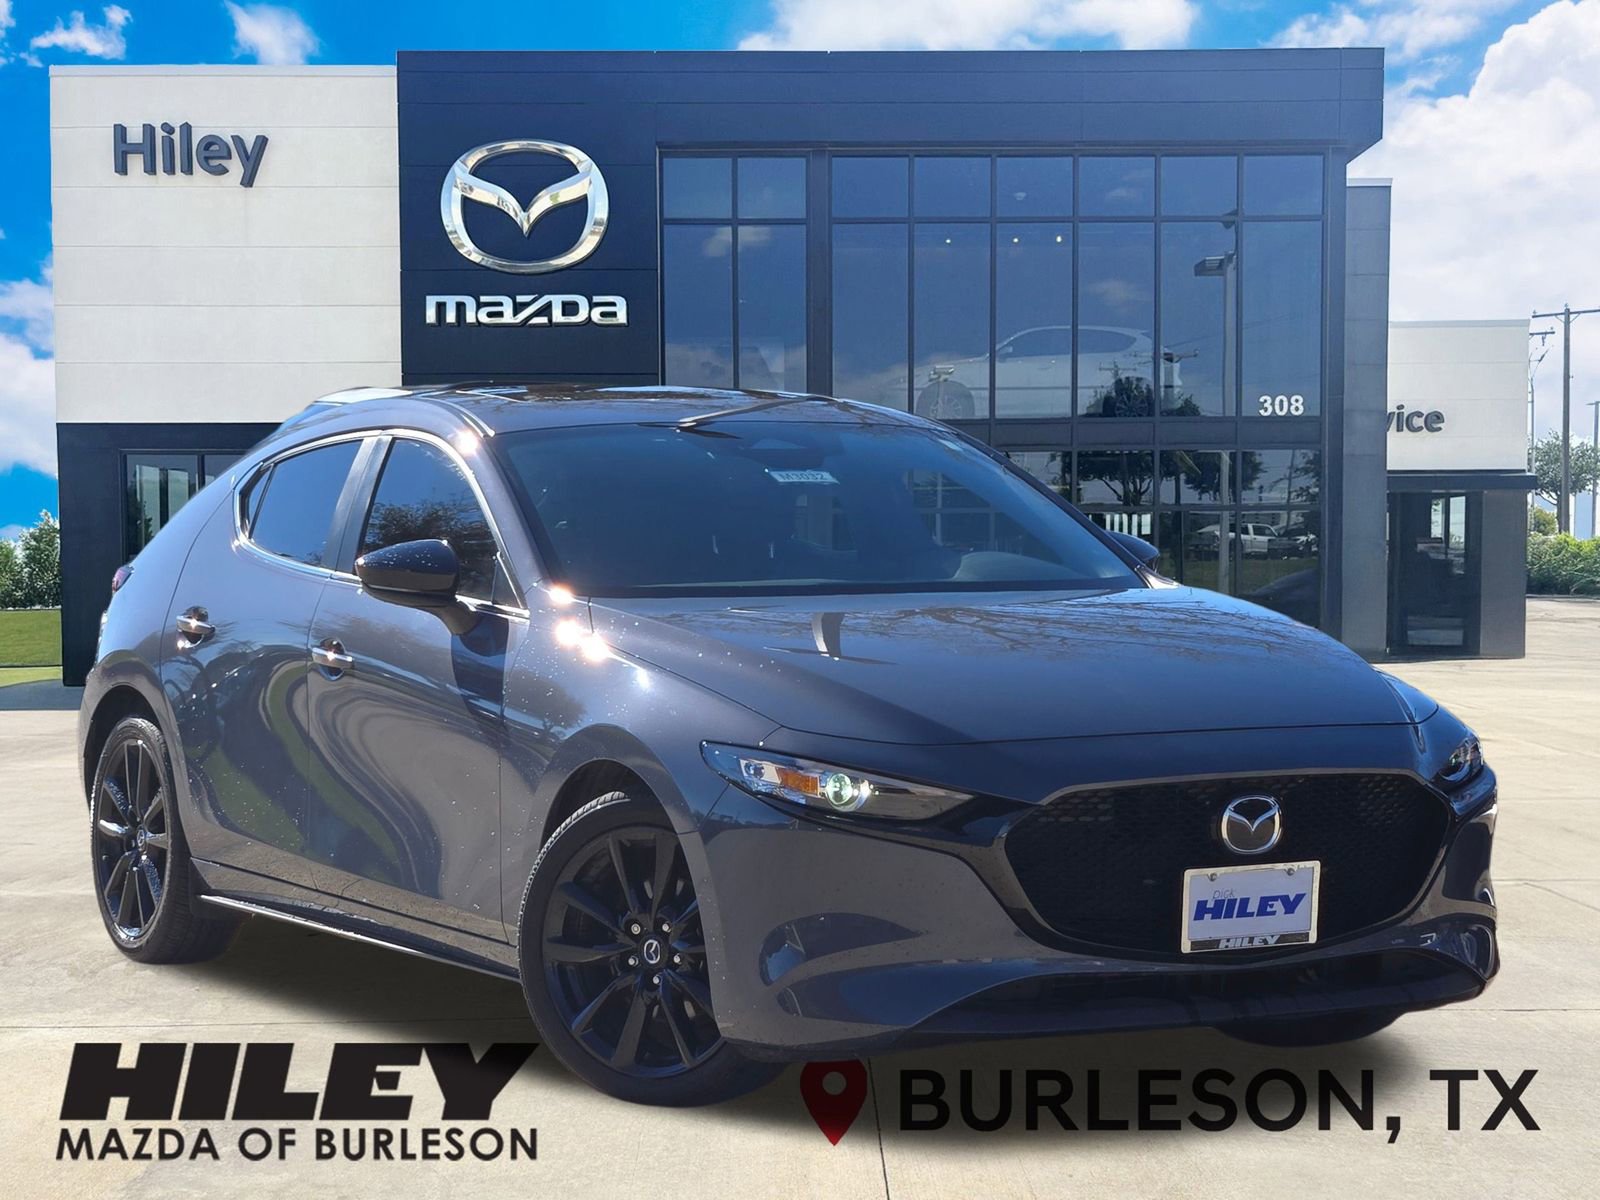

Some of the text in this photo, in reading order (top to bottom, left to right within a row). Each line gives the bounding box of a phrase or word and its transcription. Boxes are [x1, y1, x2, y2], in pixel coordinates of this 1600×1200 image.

[113, 121, 269, 188] Hiley
[1258, 394, 1304, 417] 308
[1193, 893, 1306, 921] HILEY
[1218, 934, 1281, 950] HILEY
